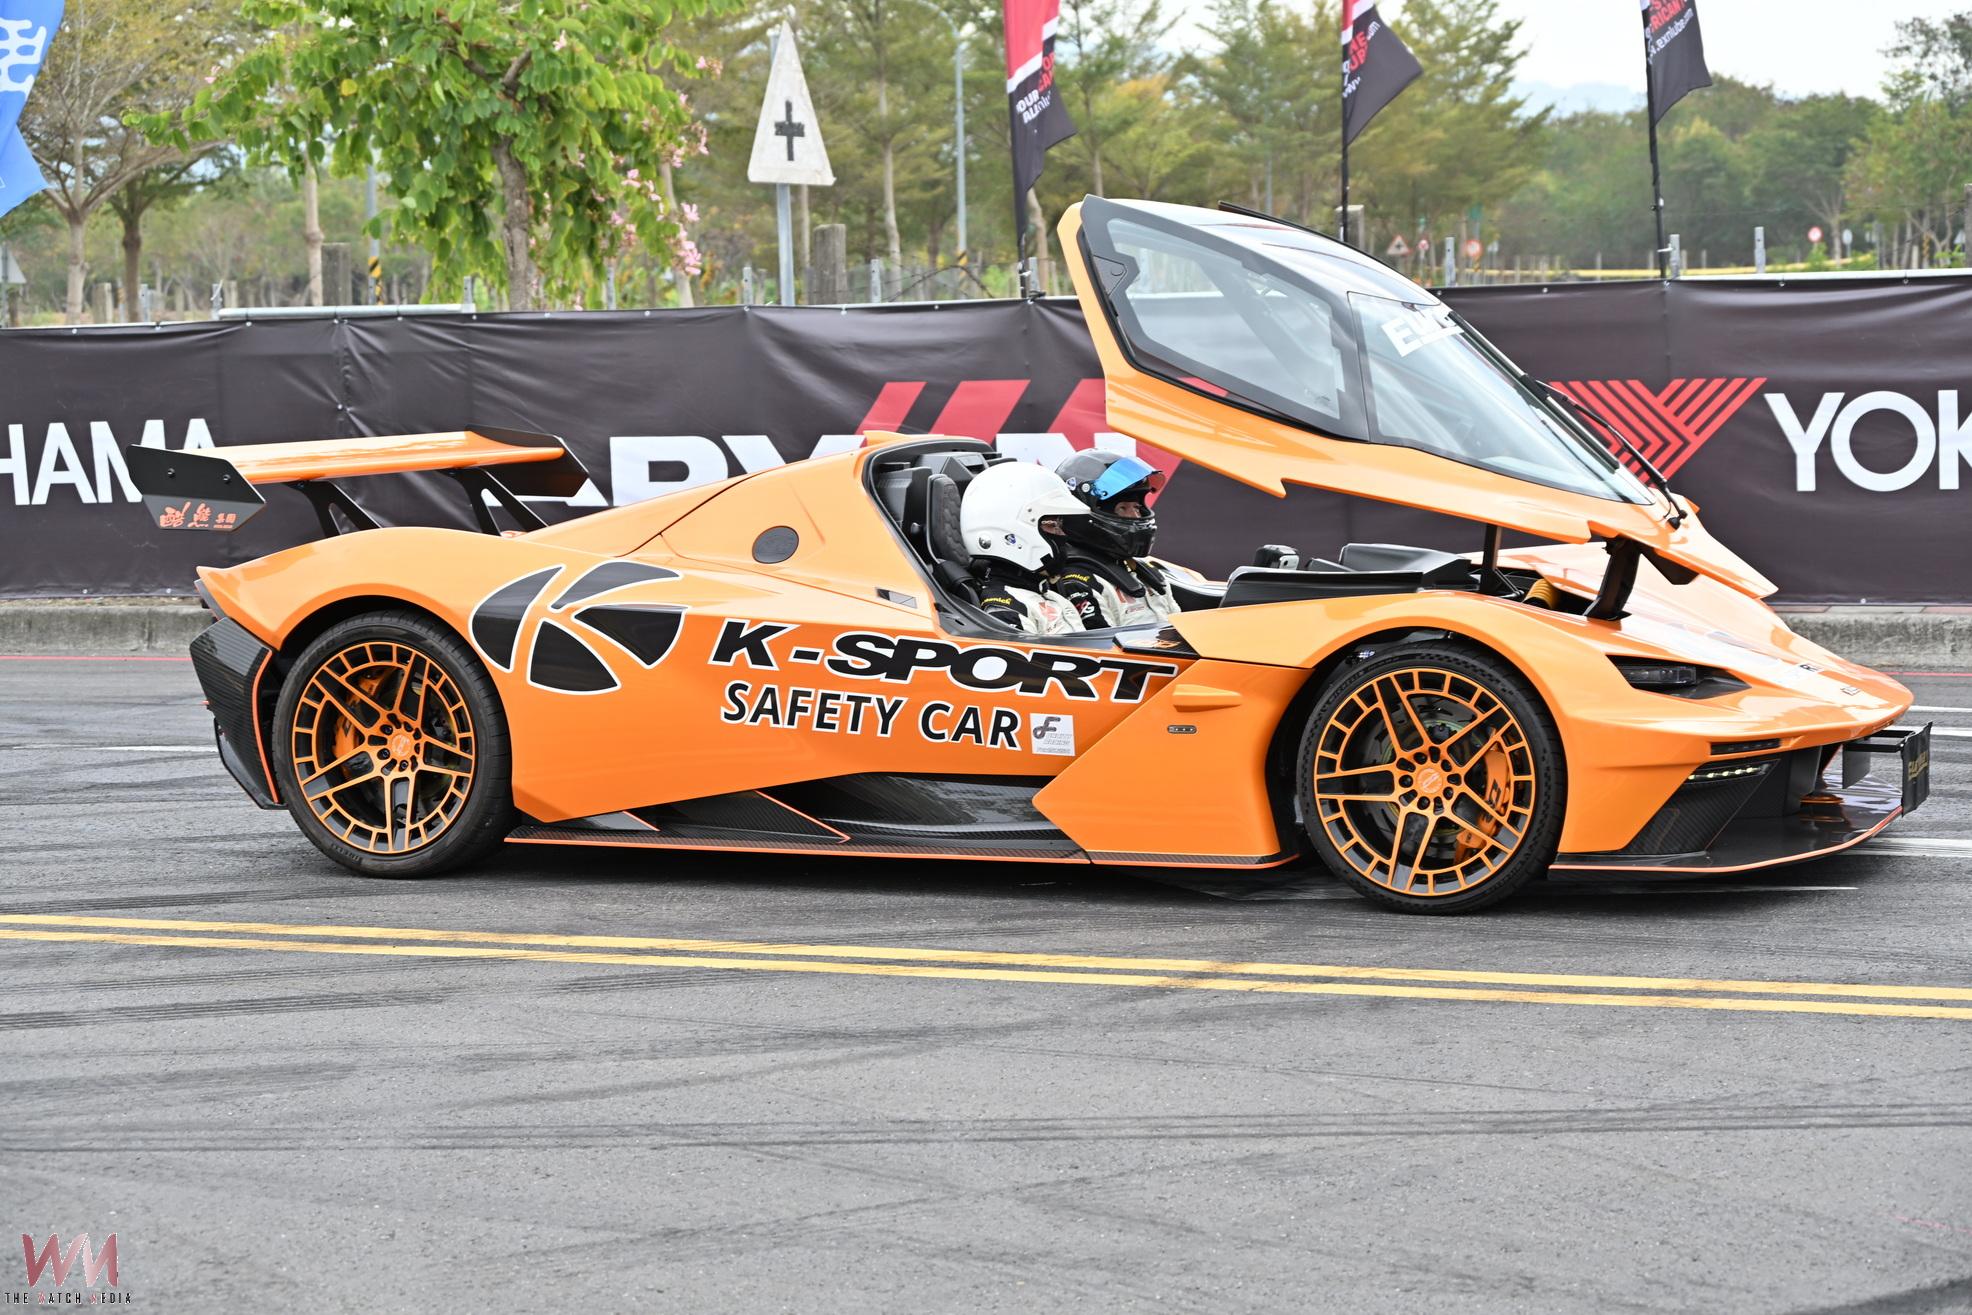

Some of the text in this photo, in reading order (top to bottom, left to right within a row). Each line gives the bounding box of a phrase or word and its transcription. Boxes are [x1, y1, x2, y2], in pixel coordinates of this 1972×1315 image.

[1764, 389, 1972, 492] YOK
[708, 617, 1178, 703] K-SPORT
[720, 681, 1022, 751] SAFETY CAR
